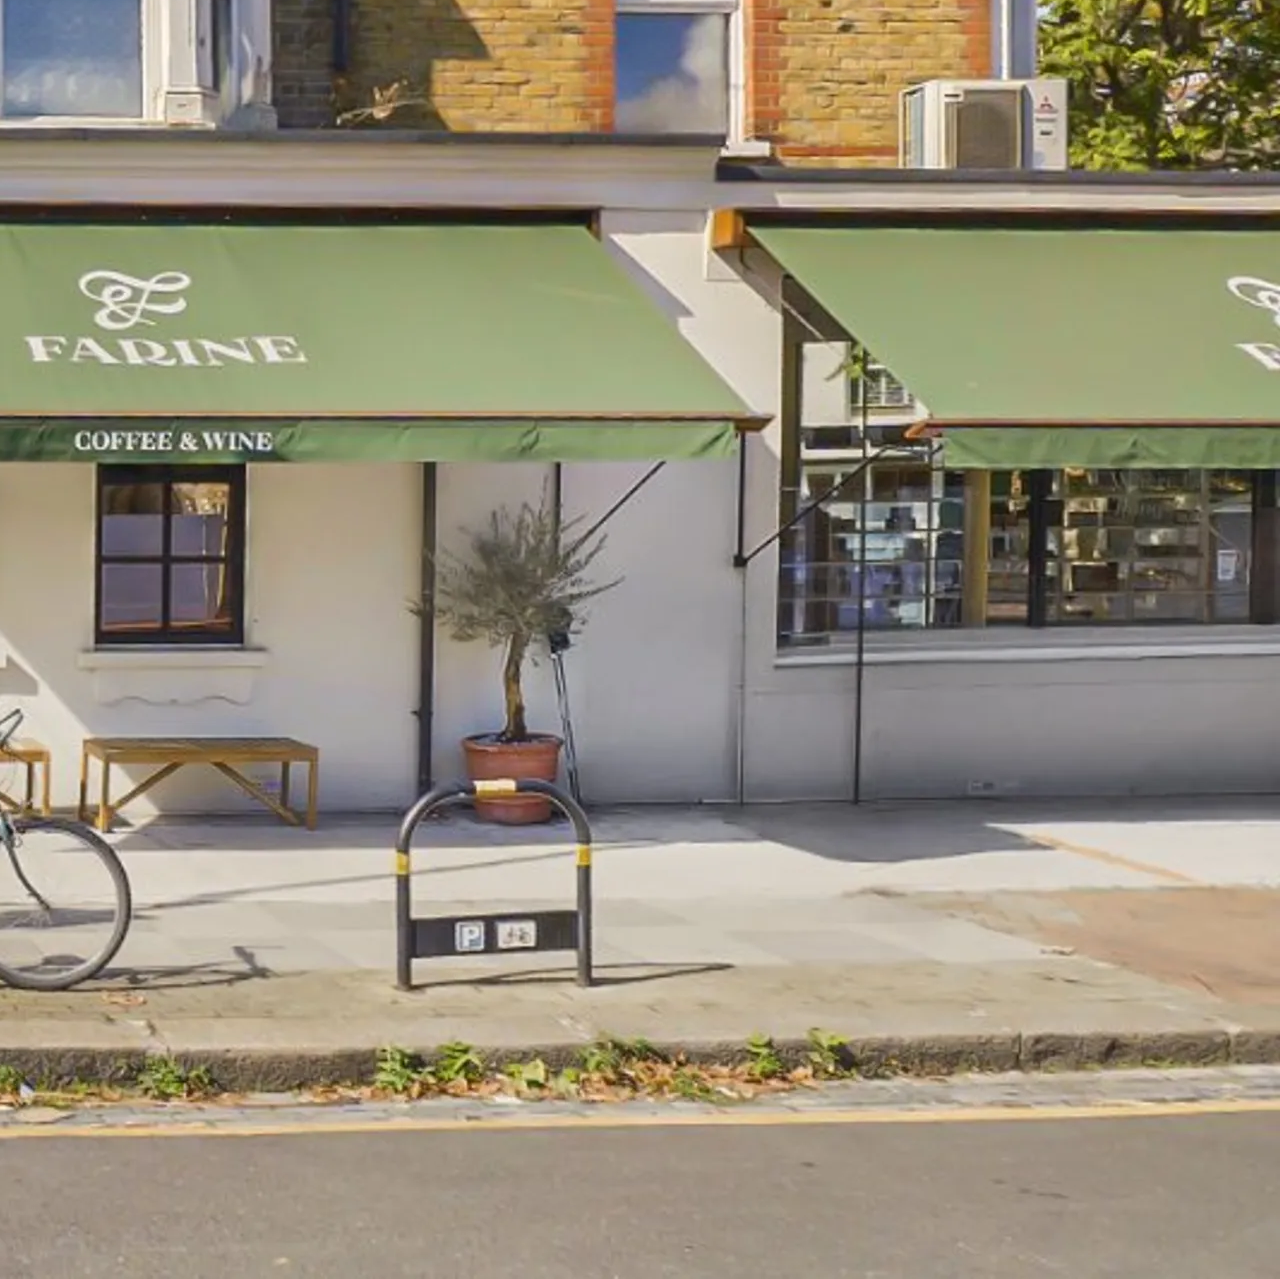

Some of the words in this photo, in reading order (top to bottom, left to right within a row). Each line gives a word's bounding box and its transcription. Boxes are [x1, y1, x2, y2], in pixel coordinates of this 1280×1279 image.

[23, 334, 309, 367] FARINE
[73, 430, 173, 452] COFFEE
[179, 430, 199, 452] &
[202, 431, 274, 453] WINE
[461, 925, 481, 948] P
